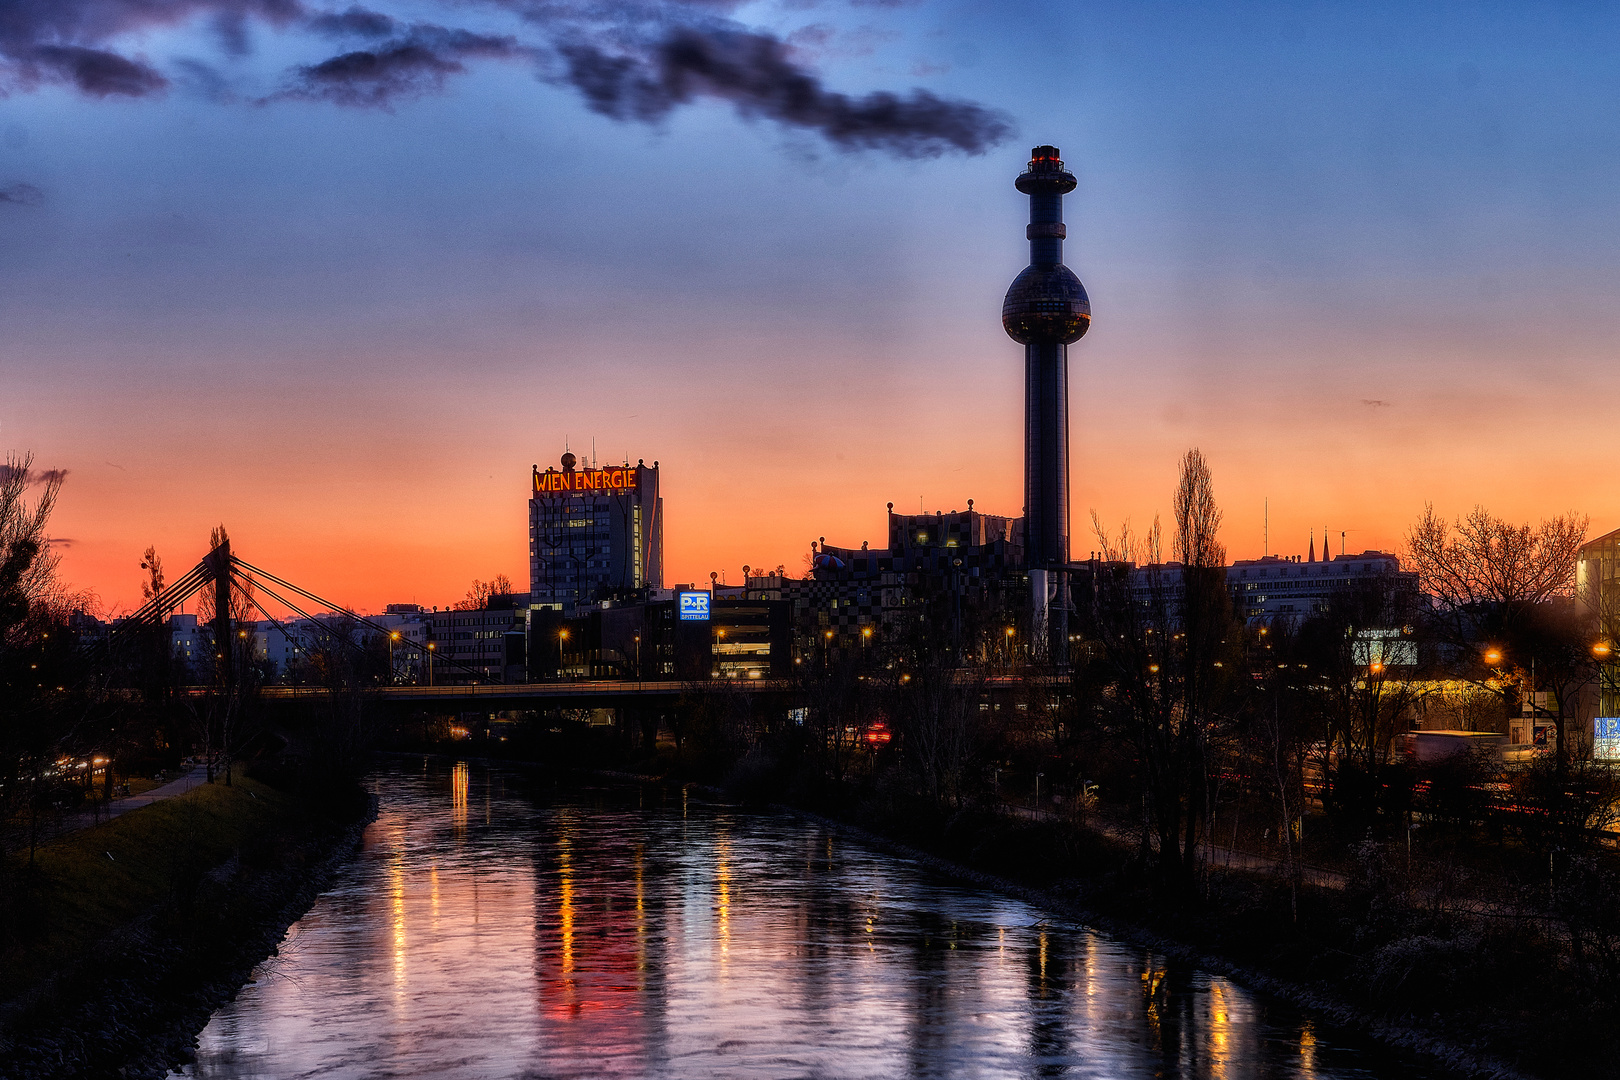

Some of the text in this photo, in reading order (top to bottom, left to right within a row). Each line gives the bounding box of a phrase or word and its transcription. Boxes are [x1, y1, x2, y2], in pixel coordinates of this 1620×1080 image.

[535, 470, 636, 491] WIEN ENERGIE
[681, 597, 709, 611] P+R
